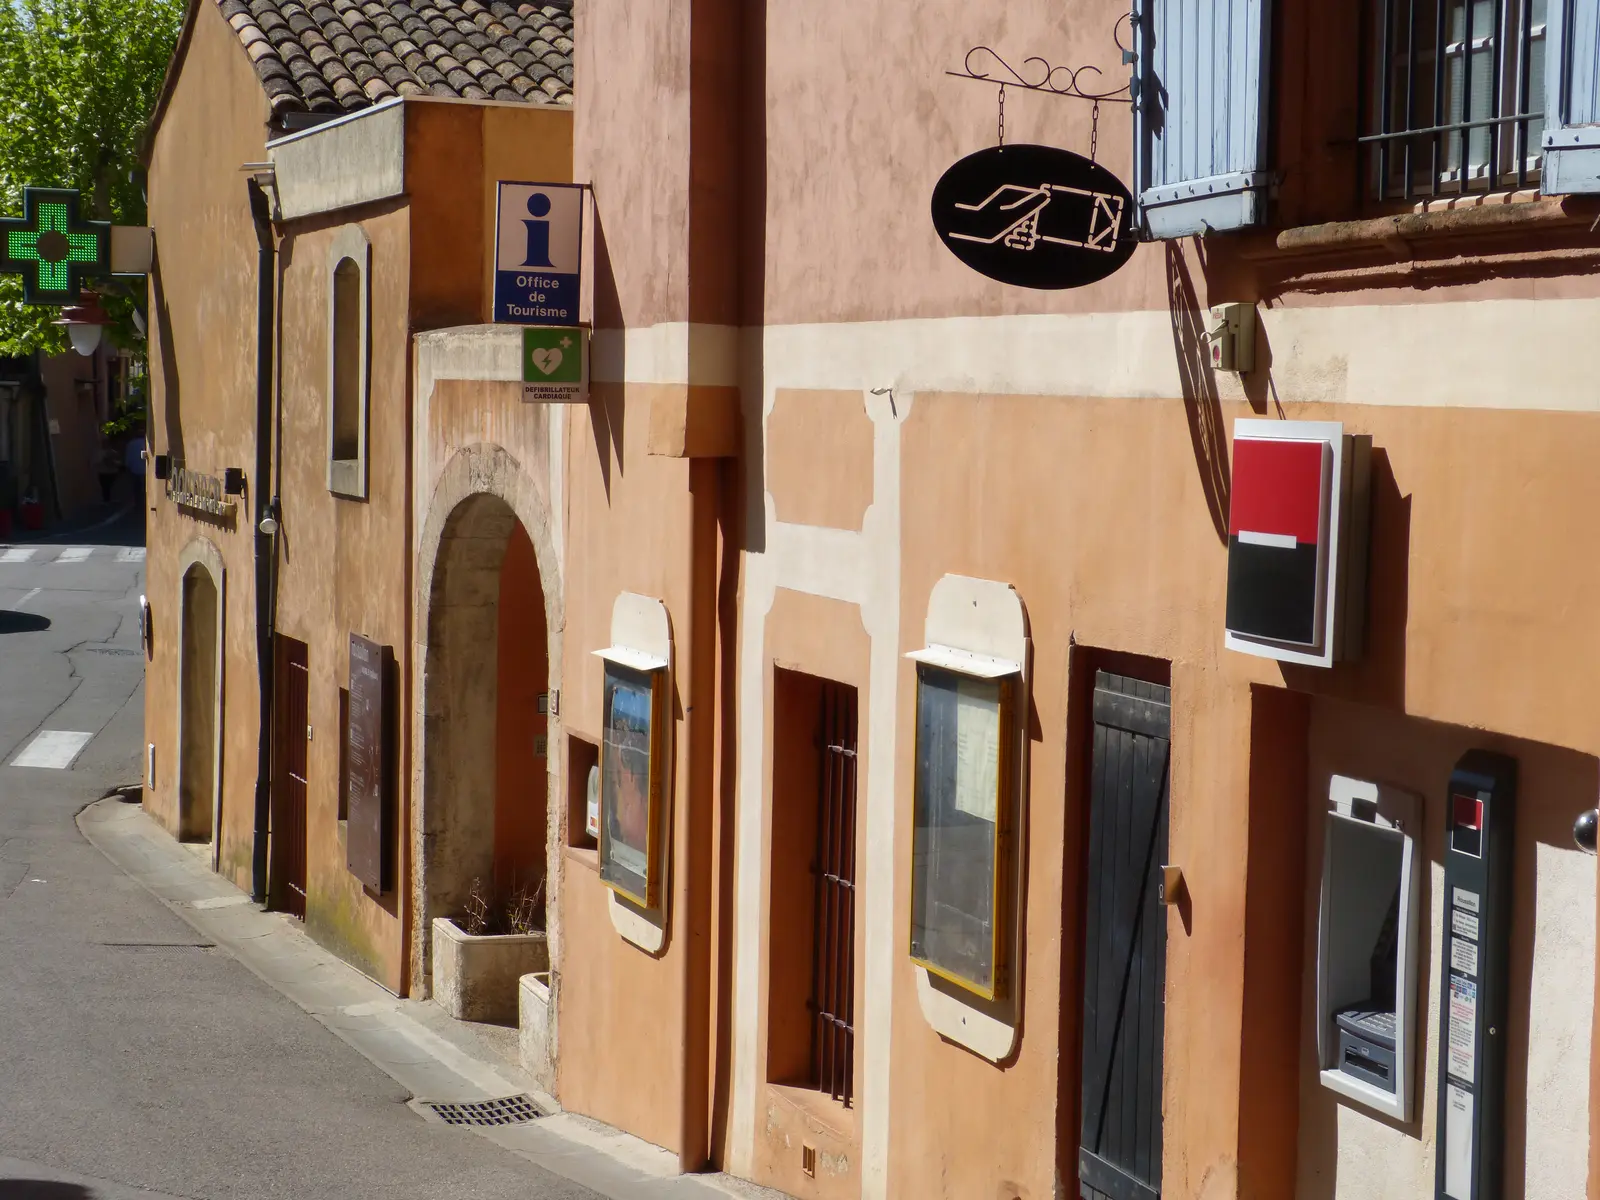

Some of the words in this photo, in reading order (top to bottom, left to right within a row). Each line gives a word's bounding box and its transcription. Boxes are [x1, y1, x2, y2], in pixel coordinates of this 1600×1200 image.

[516, 275, 560, 289] Office
[529, 291, 546, 303] de
[506, 303, 568, 318] Tourisme
